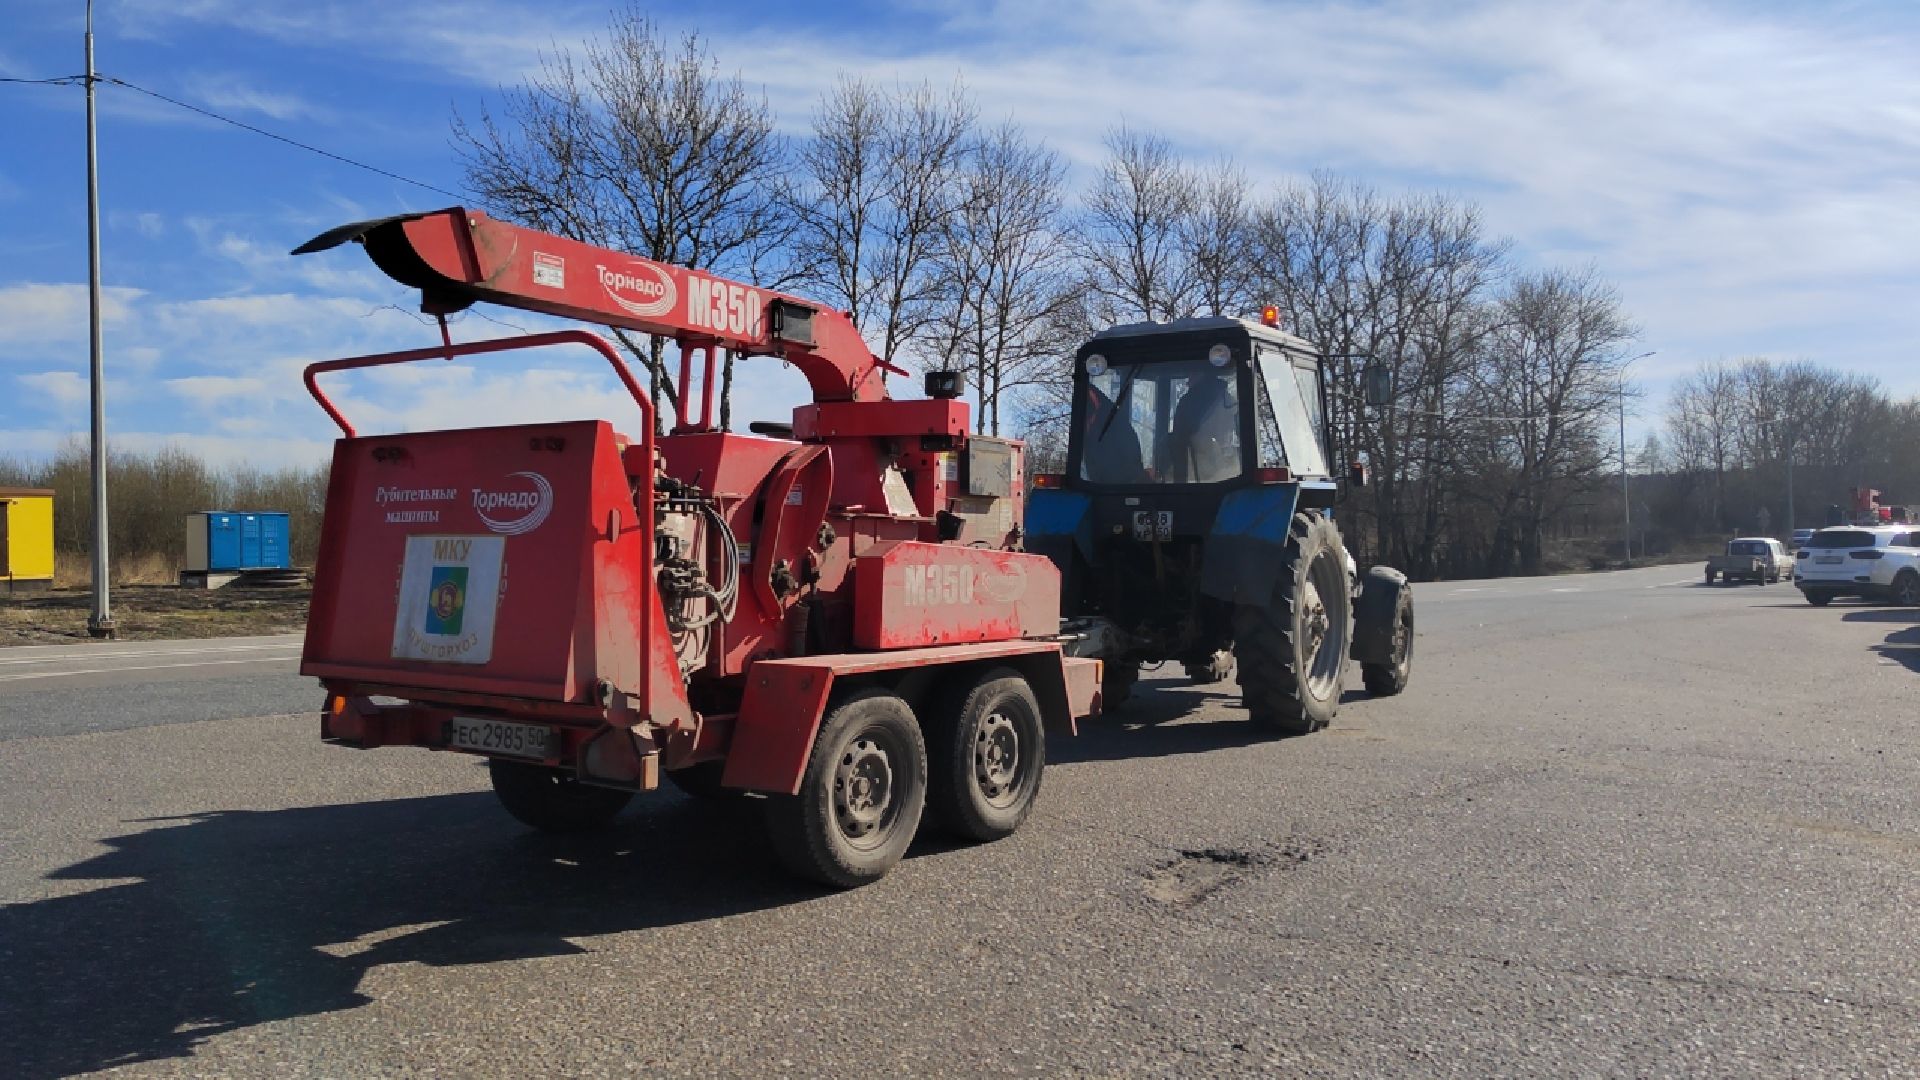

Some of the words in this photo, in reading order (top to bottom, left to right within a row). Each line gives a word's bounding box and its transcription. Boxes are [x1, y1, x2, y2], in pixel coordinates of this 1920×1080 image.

[595, 264, 665, 298] Торнадо
[375, 486, 458, 507] Рубительные
[471, 488, 539, 511] Торнадо
[384, 510, 440, 523] машины
[432, 539, 473, 561] МКУ
